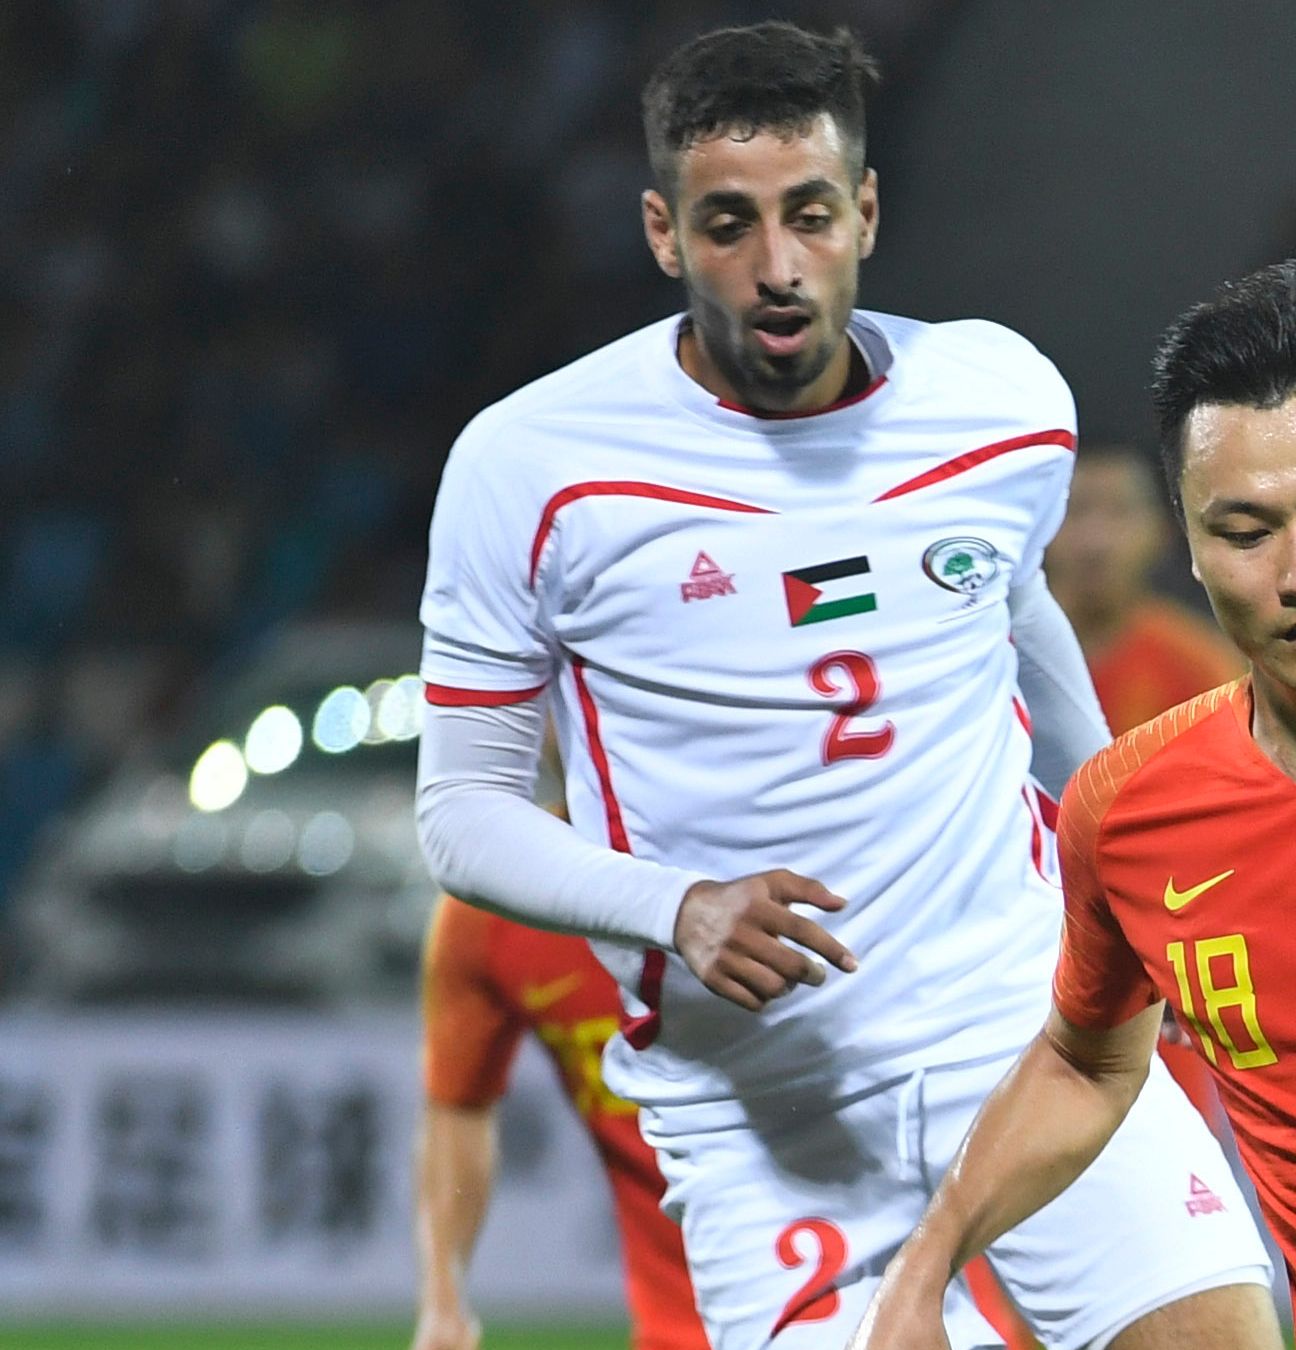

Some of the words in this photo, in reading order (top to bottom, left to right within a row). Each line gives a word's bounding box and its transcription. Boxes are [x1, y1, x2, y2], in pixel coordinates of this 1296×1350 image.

[806, 649, 896, 767] 2
[1166, 933, 1279, 1070] 18
[768, 1216, 849, 1341] 2
